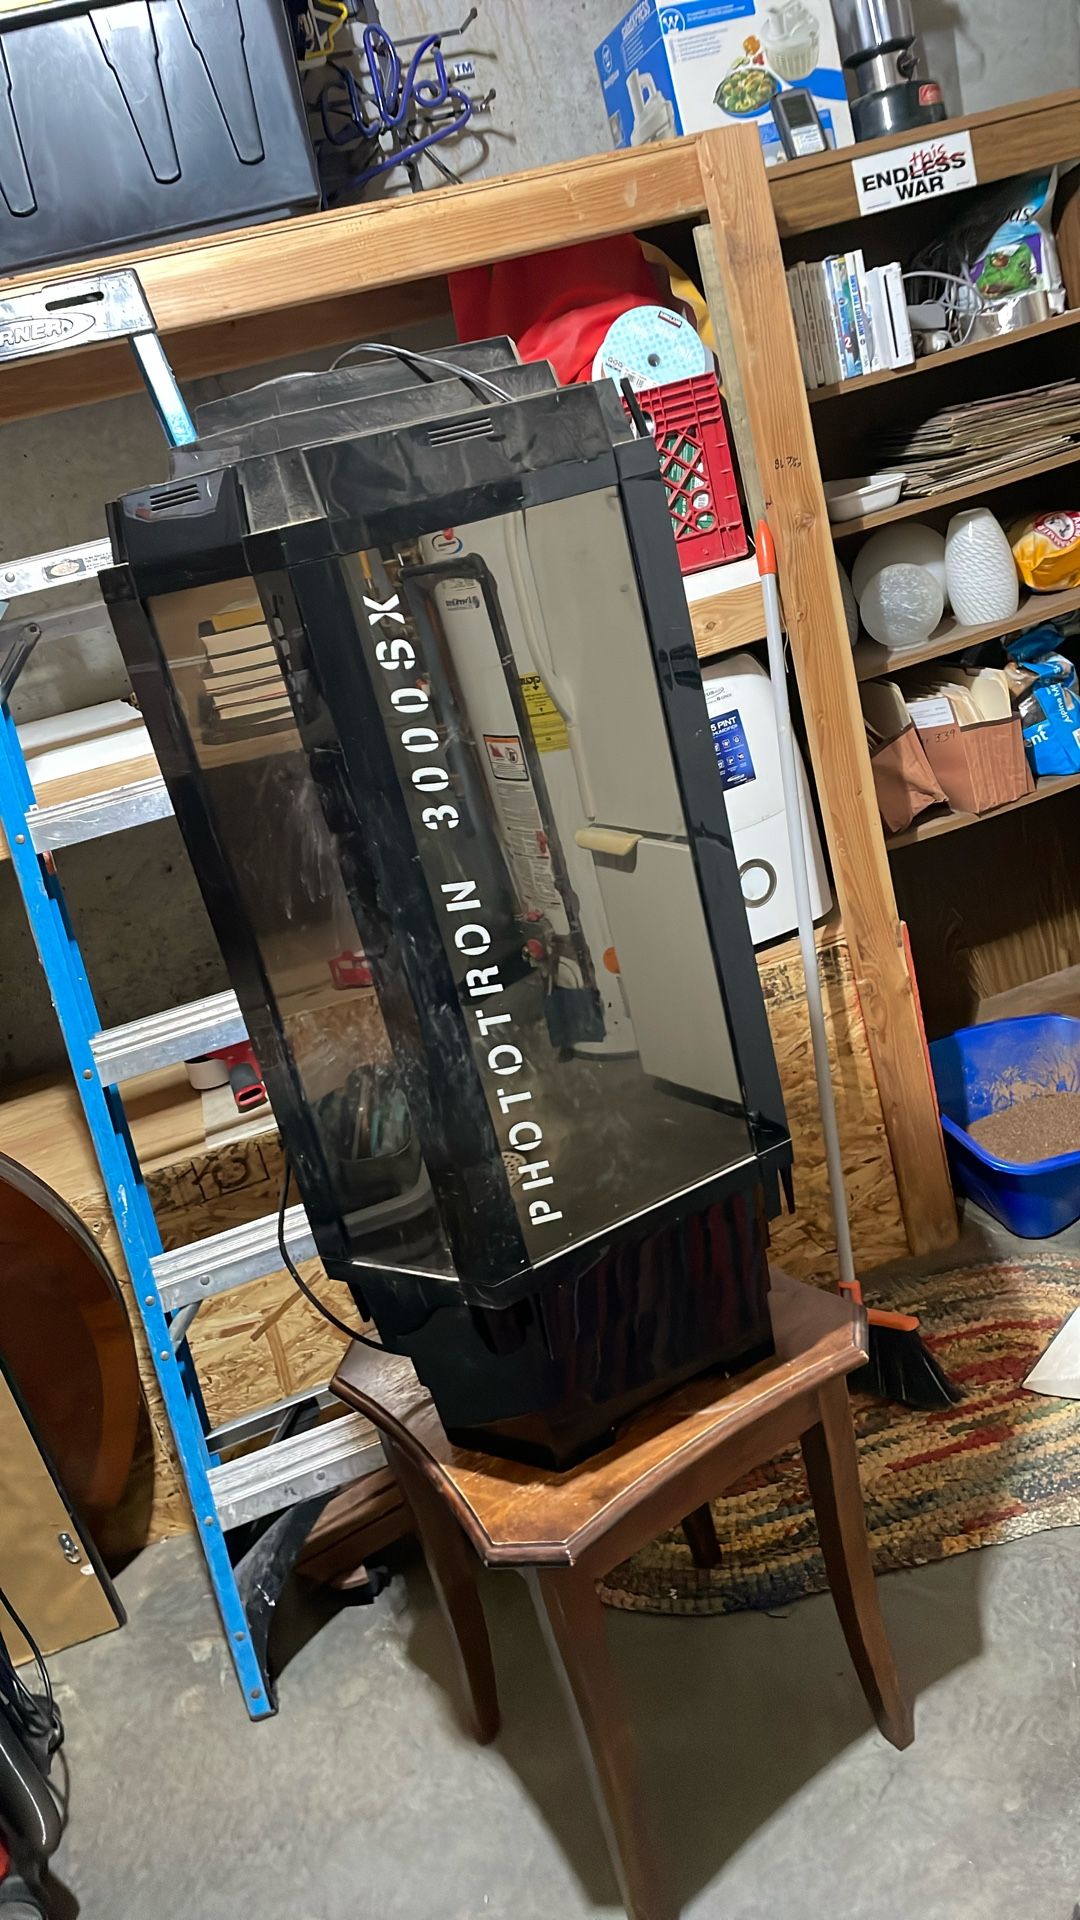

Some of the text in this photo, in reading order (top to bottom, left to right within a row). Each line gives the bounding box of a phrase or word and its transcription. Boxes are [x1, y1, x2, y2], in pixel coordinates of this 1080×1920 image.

[454, 61, 473, 74] TM
[909, 143, 946, 168] this
[861, 153, 967, 193] ENDLESS
[896, 175, 945, 201] WAR
[717, 716, 737, 731] PINT
[1055, 697, 1074, 724] Alpine
[440, 880, 563, 1226] PHOTOTRON
